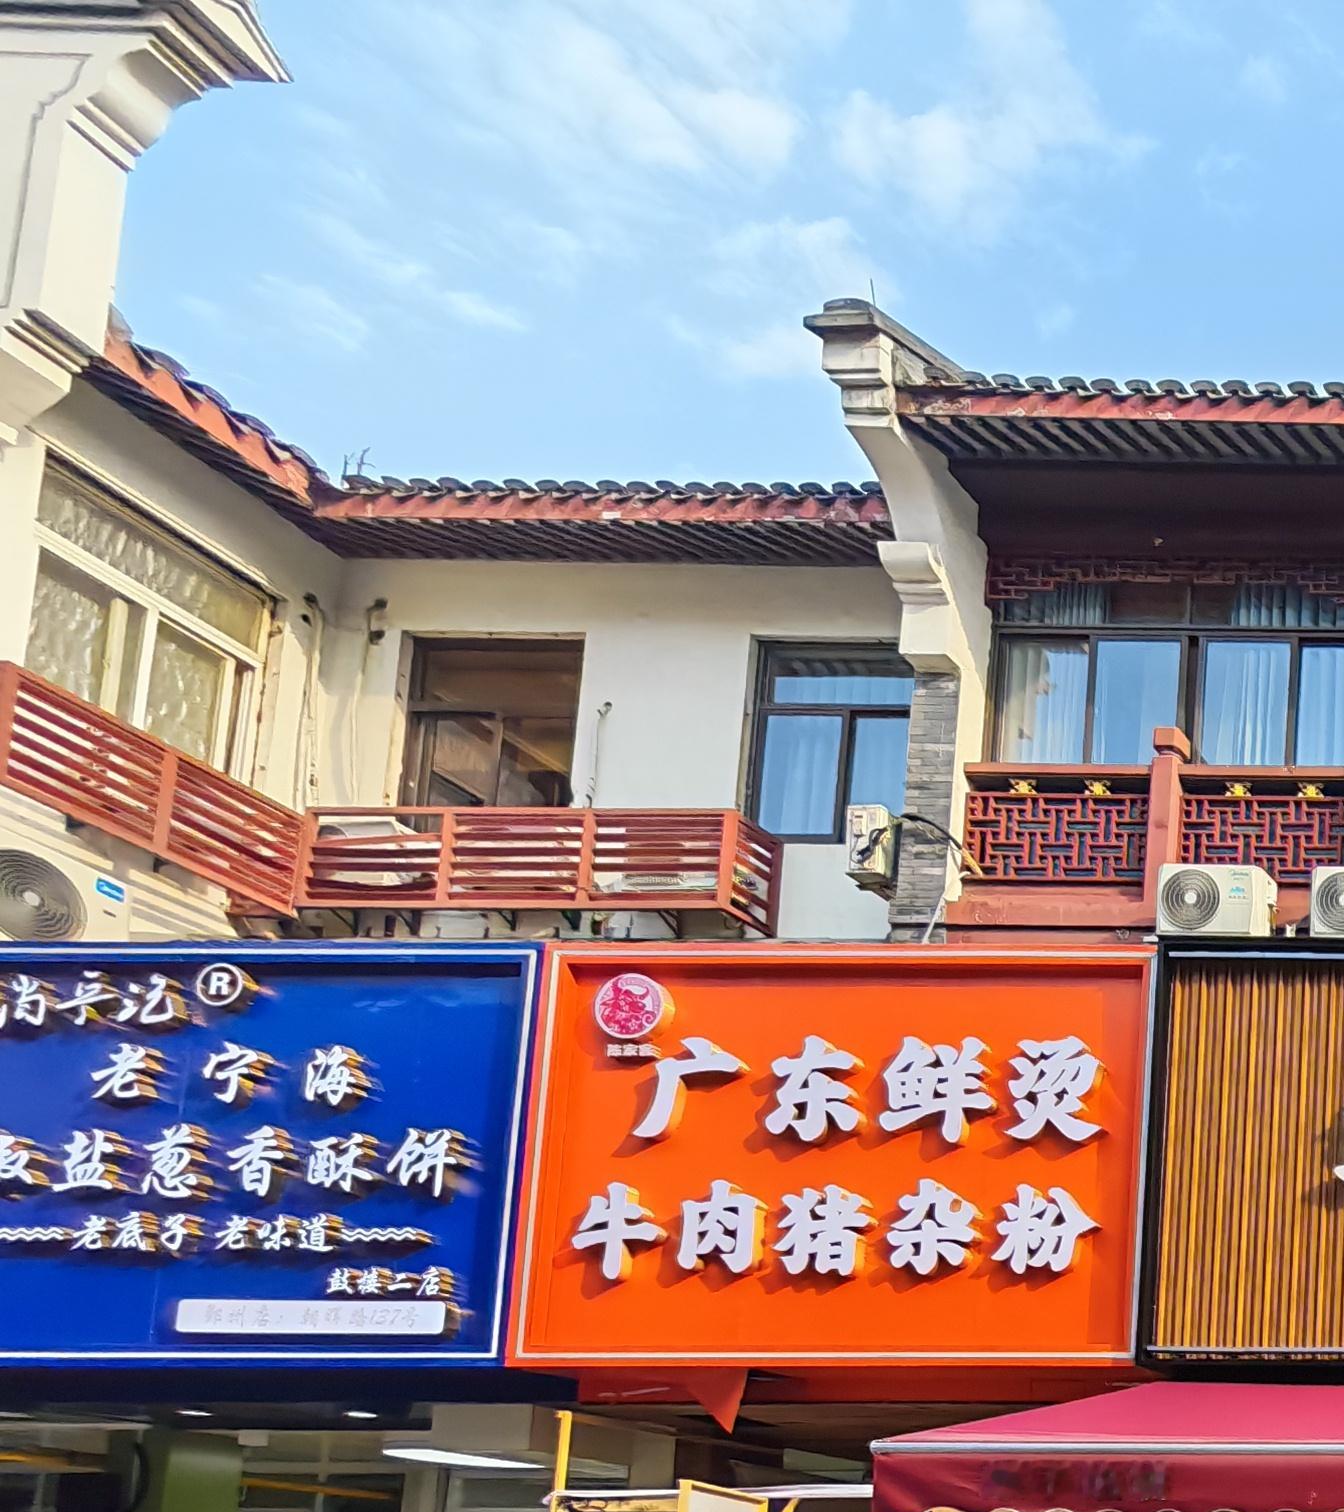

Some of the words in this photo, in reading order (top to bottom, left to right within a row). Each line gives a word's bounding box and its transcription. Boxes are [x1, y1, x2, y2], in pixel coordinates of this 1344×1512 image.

[90, 1041, 358, 1105] 老宁海
[633, 1036, 1103, 1143] 广东鲜烫
[215, 1214, 335, 1252] 老味道
[571, 1178, 1097, 1281] 牛肉猪杂粉
[326, 1266, 441, 1297] 鼓楼二店
